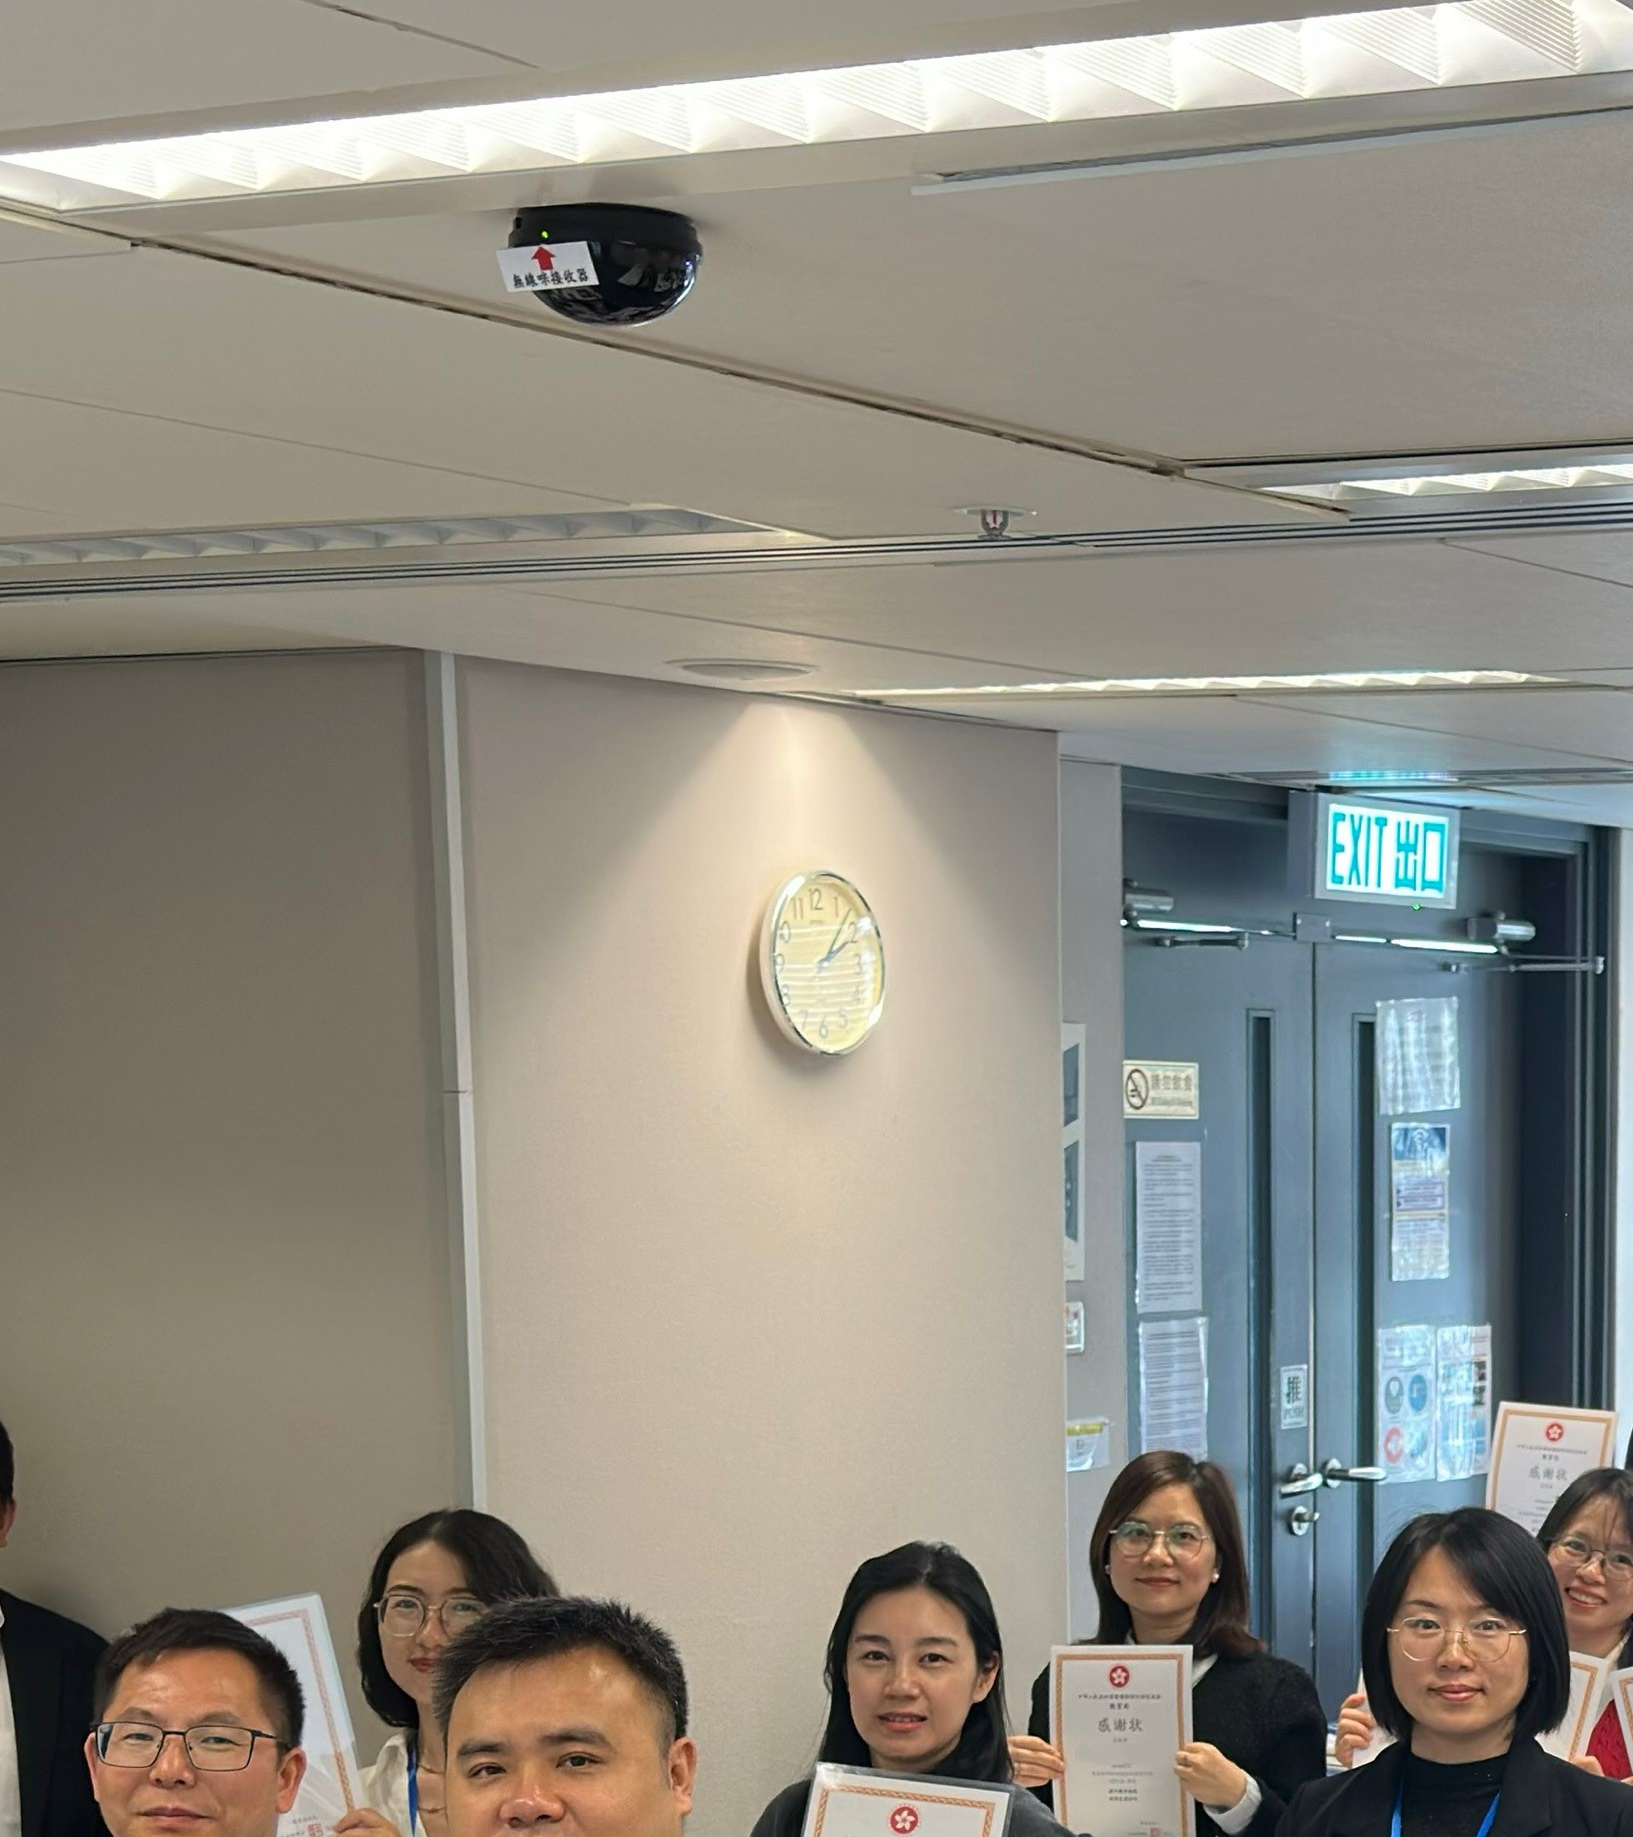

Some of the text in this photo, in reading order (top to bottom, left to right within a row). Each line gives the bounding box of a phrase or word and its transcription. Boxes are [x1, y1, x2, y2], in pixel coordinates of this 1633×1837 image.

[513, 268, 589, 289] 無線咪接收器
[1331, 811, 1446, 893] EXIT 出口
[792, 897, 804, 920] 11
[808, 888, 824, 911] 12
[832, 896, 839, 918] 1
[848, 922, 858, 944] 2
[819, 1015, 829, 1038] 6
[1098, 1718, 1143, 1733] 感谢状
